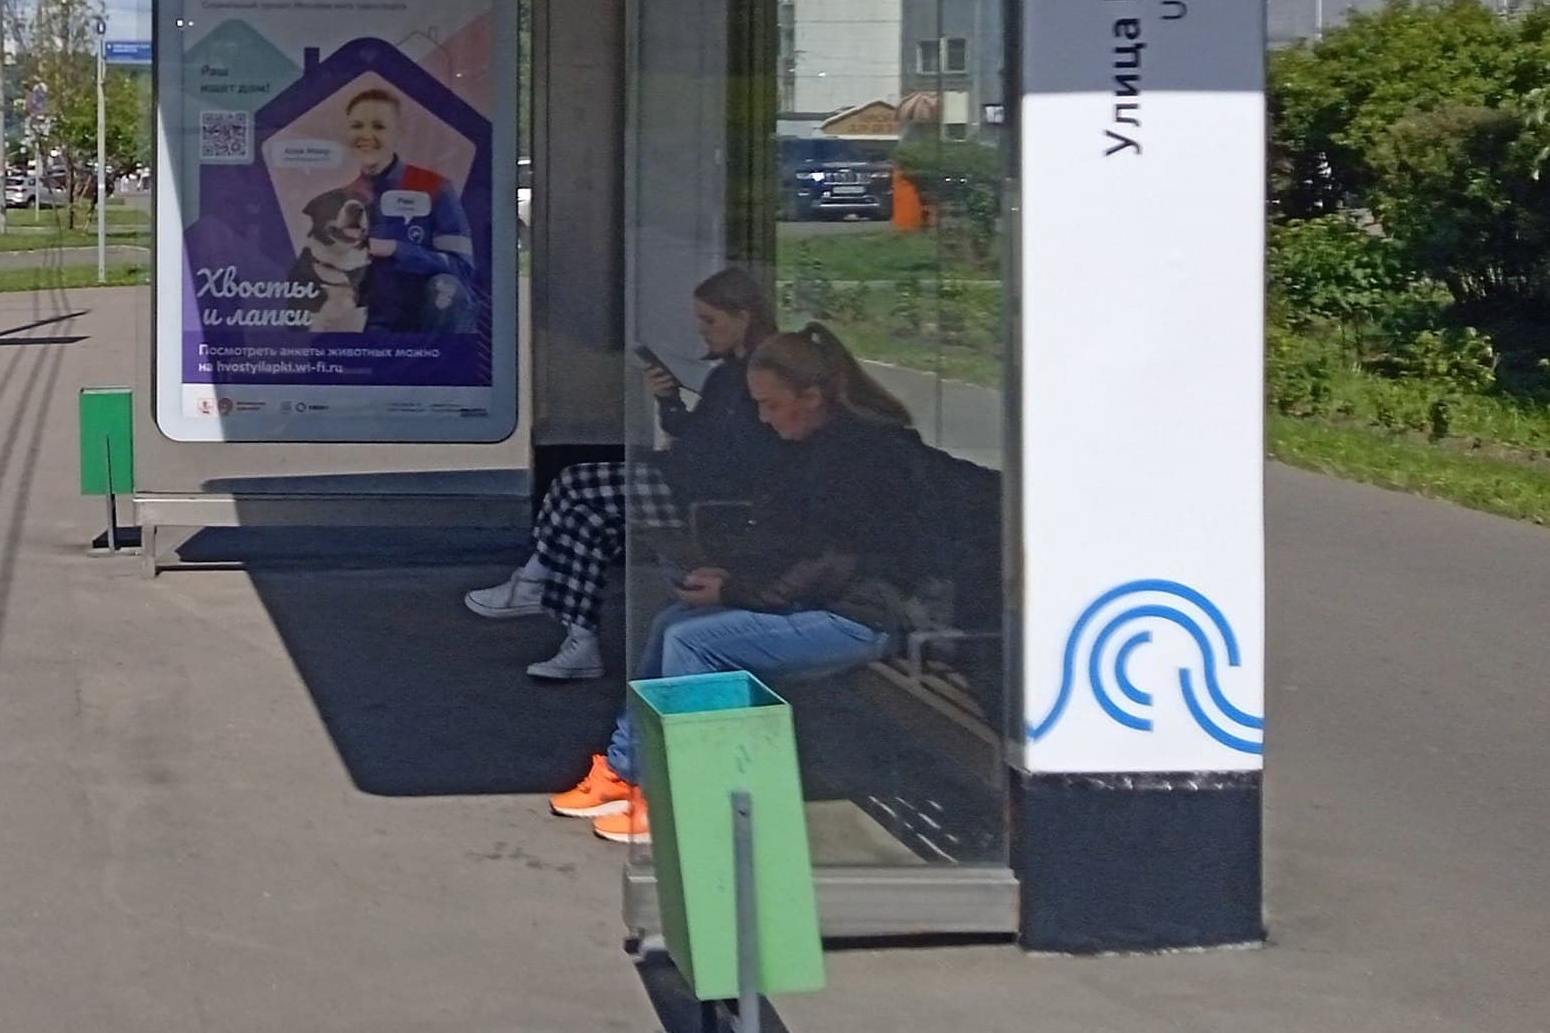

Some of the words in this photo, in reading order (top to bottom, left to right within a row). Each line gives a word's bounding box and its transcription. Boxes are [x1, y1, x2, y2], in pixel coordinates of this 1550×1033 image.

[1103, 17, 1148, 157] Улица
[196, 265, 321, 298] Хвосты
[203, 308, 223, 326] и
[226, 309, 313, 326] лапки
[198, 344, 277, 358] Посмотреть
[279, 347, 325, 357] анкеты
[328, 347, 392, 358] животных
[395, 348, 440, 358] можно
[198, 362, 213, 372] на
